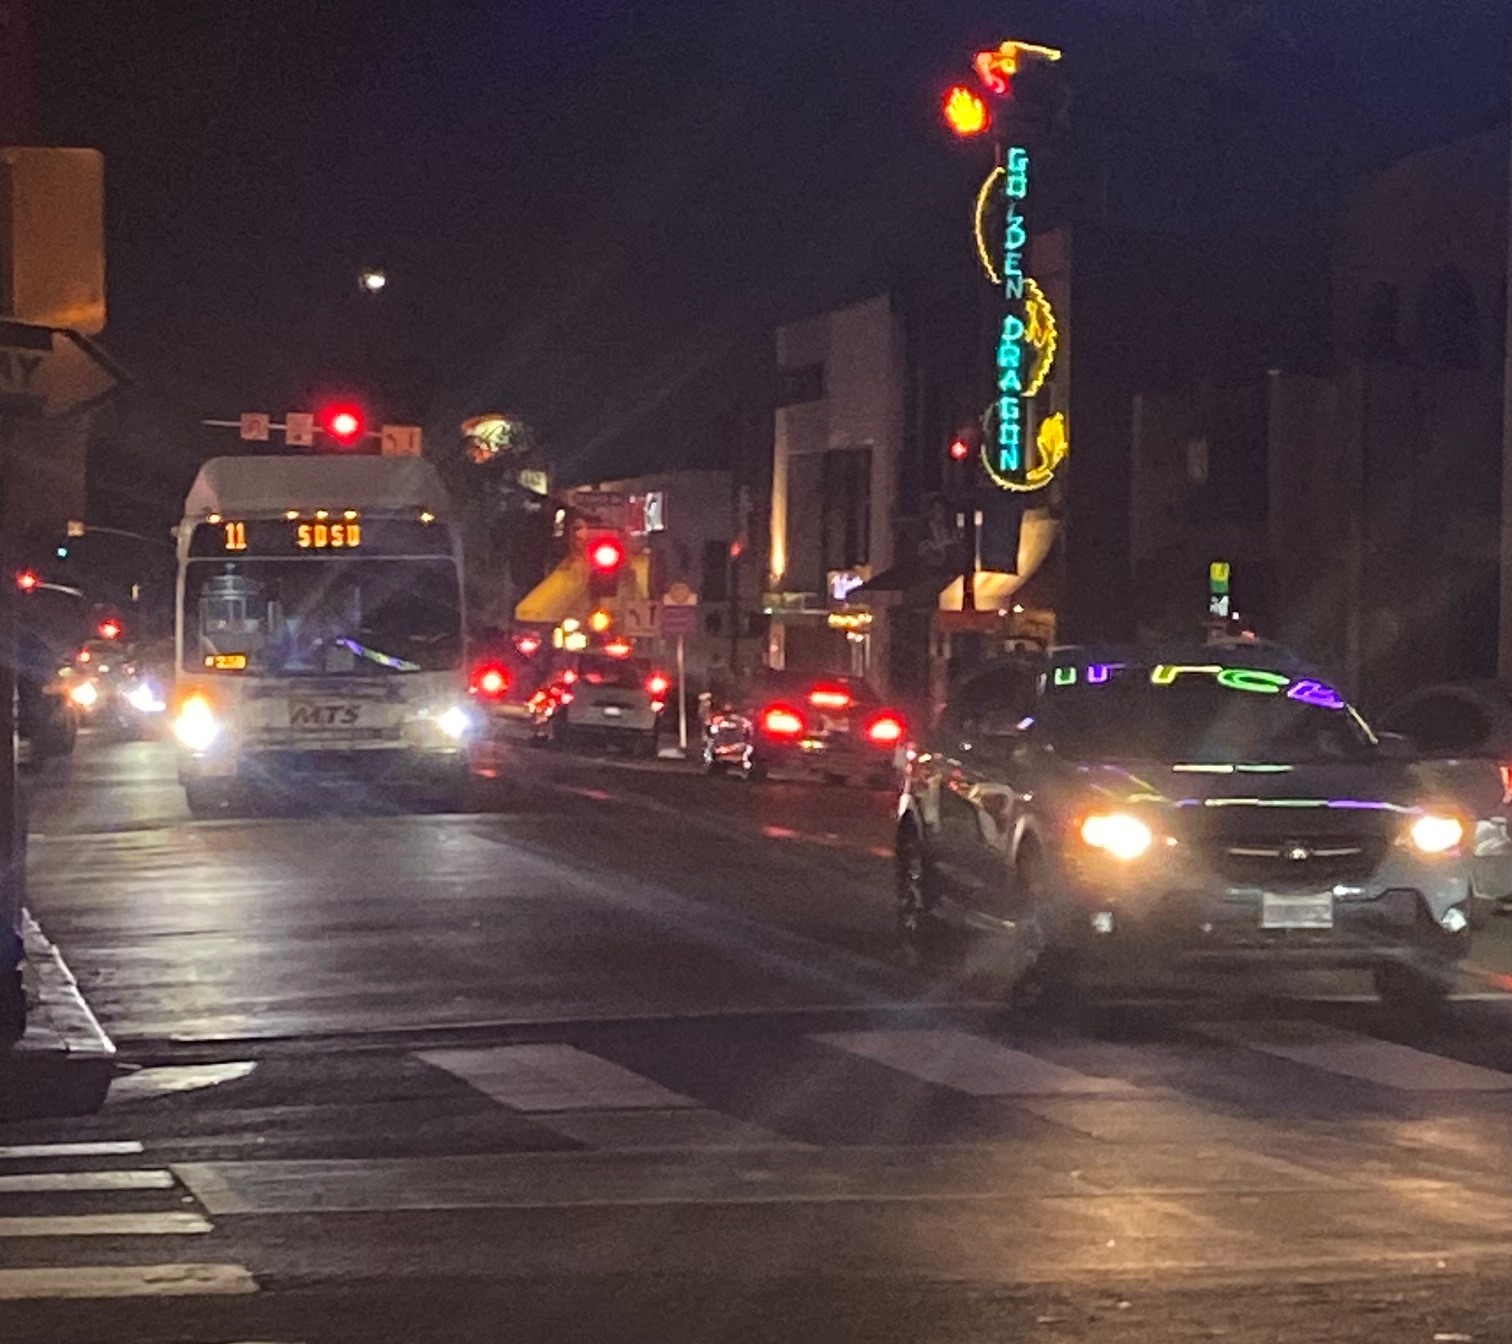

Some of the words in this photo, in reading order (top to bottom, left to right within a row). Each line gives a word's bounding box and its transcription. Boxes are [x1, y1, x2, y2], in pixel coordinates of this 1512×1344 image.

[1003, 146, 1030, 300] GOLDEN
[996, 315, 1025, 472] DRAGON
[224, 522, 248, 551] 11
[289, 704, 362, 725] MTS
